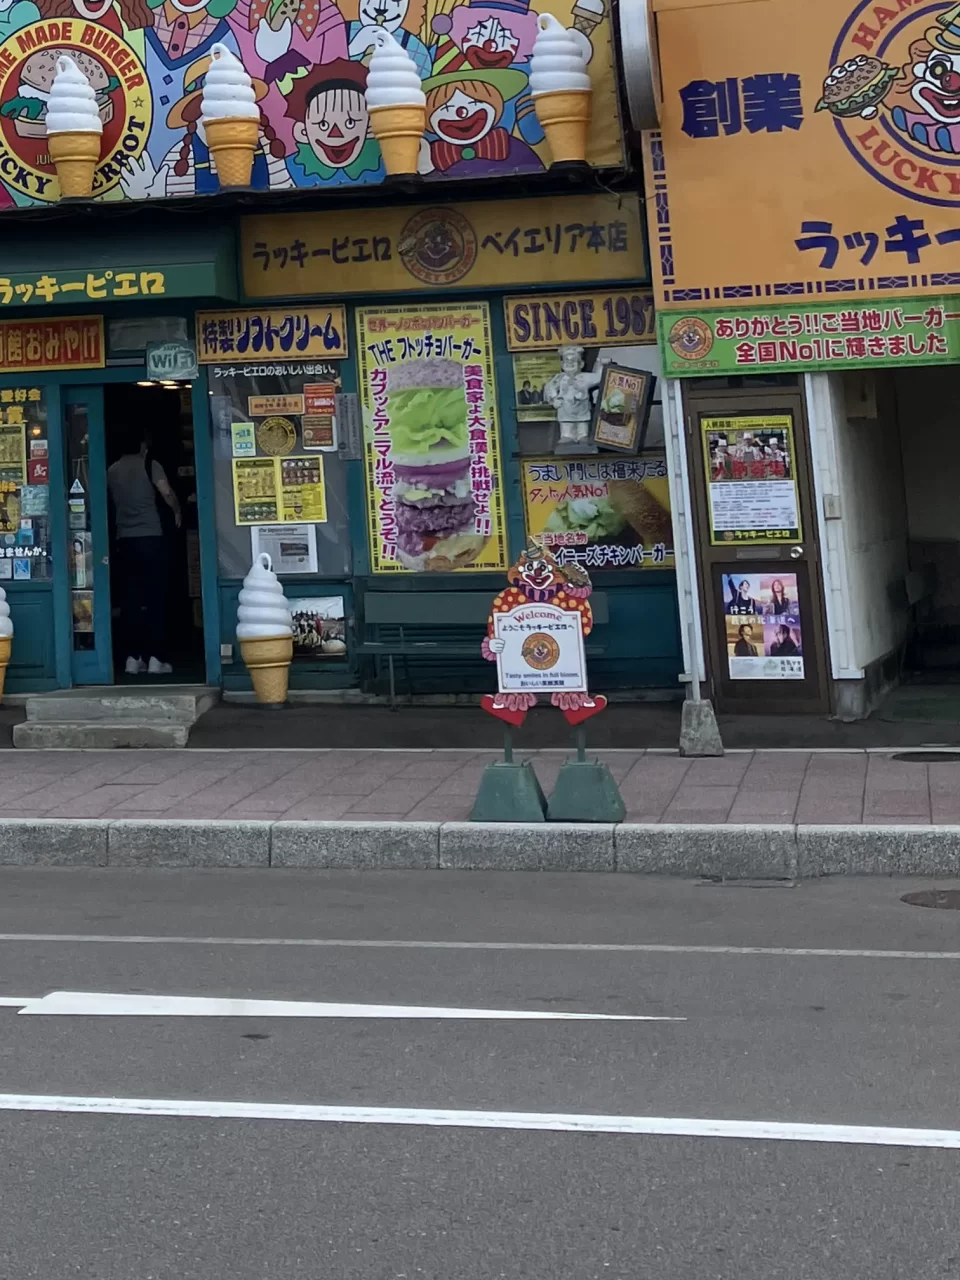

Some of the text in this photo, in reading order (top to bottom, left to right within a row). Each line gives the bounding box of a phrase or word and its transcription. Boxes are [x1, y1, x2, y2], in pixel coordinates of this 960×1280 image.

[16, 22, 73, 54] MADE
[80, 23, 145, 91] BURGER
[680, 73, 804, 138] 創業
[91, 115, 146, 192] ERROT
[252, 235, 392, 271] ラッキーピエロ
[481, 220, 628, 258] ベイエリア本店
[513, 295, 656, 343] SINCE 1987
[367, 334, 482, 366] THE フトッチョバーガー
[551, 542, 676, 568] イニーズチキンバーガー
[513, 610, 563, 624] Welcome
